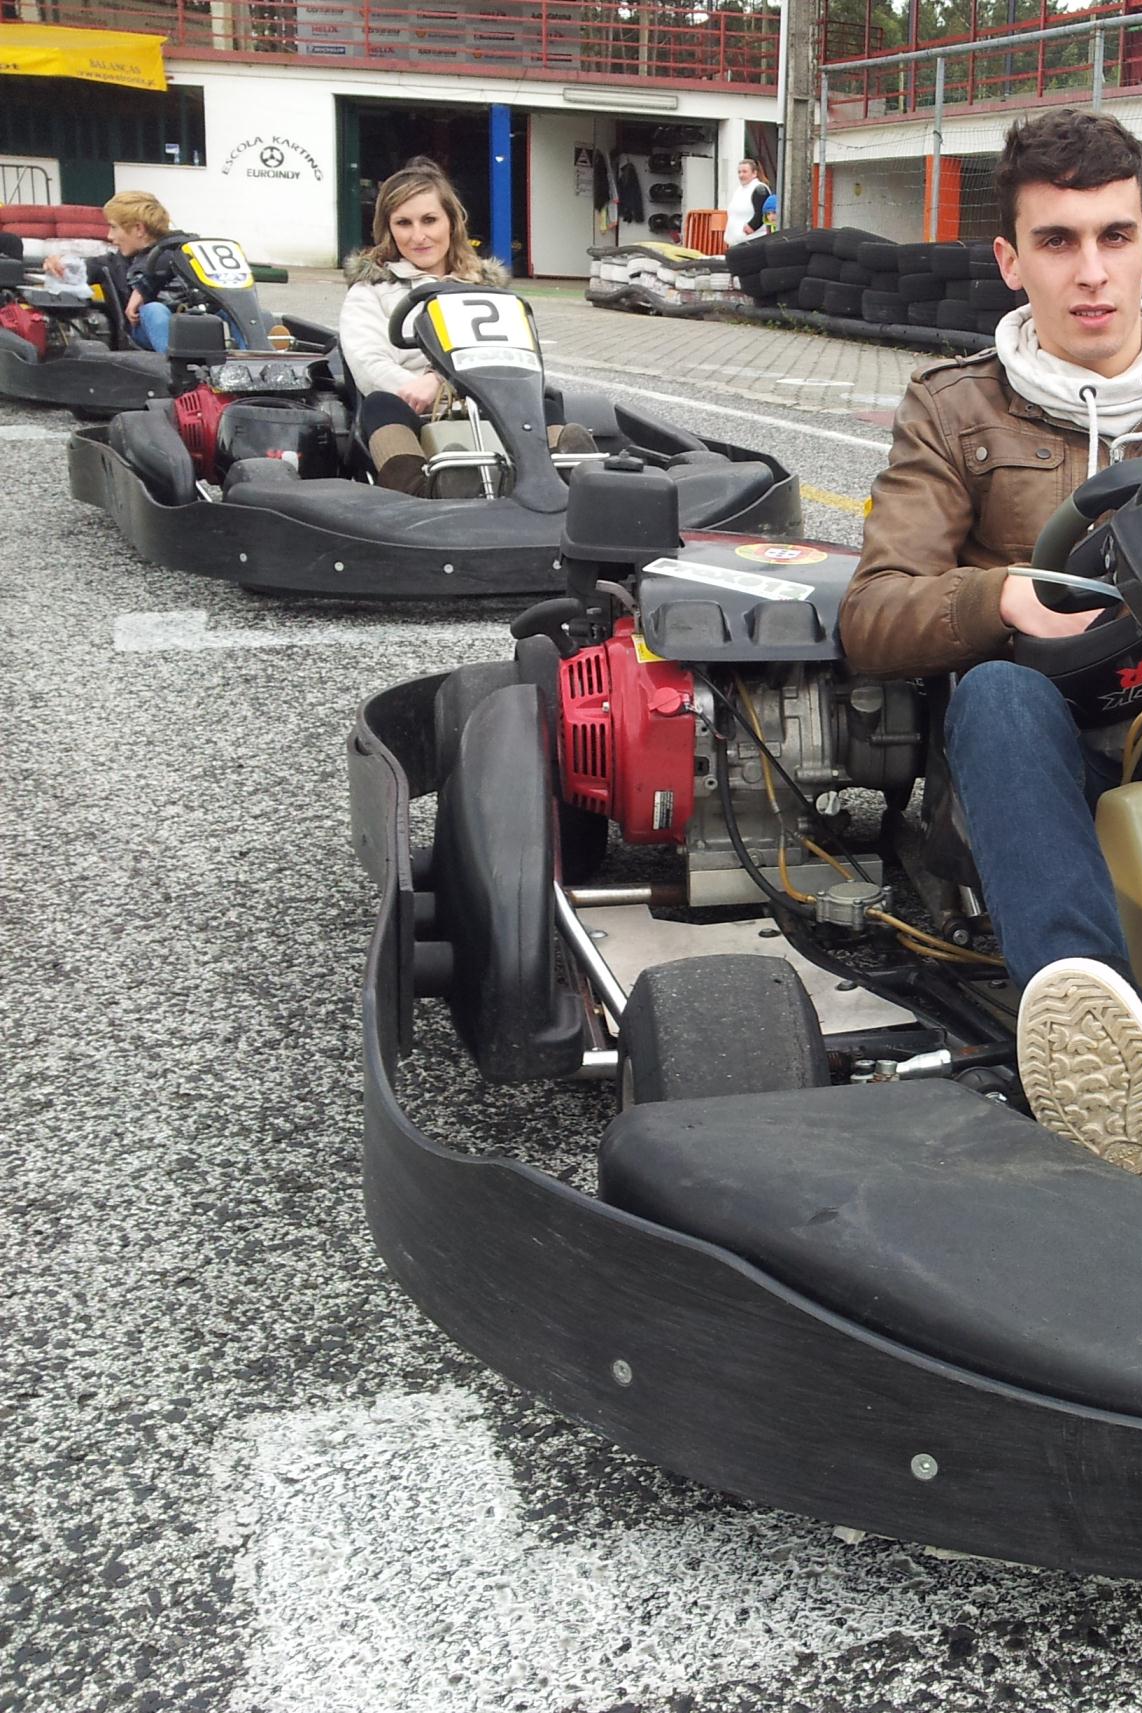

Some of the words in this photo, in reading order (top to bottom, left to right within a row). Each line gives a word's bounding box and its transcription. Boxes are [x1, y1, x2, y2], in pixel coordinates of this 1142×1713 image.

[222, 136, 264, 175] ESCOLA
[271, 135, 324, 182] KARTING
[245, 167, 301, 180] EUROINDY
[197, 244, 241, 271] 18
[461, 299, 509, 342] 2
